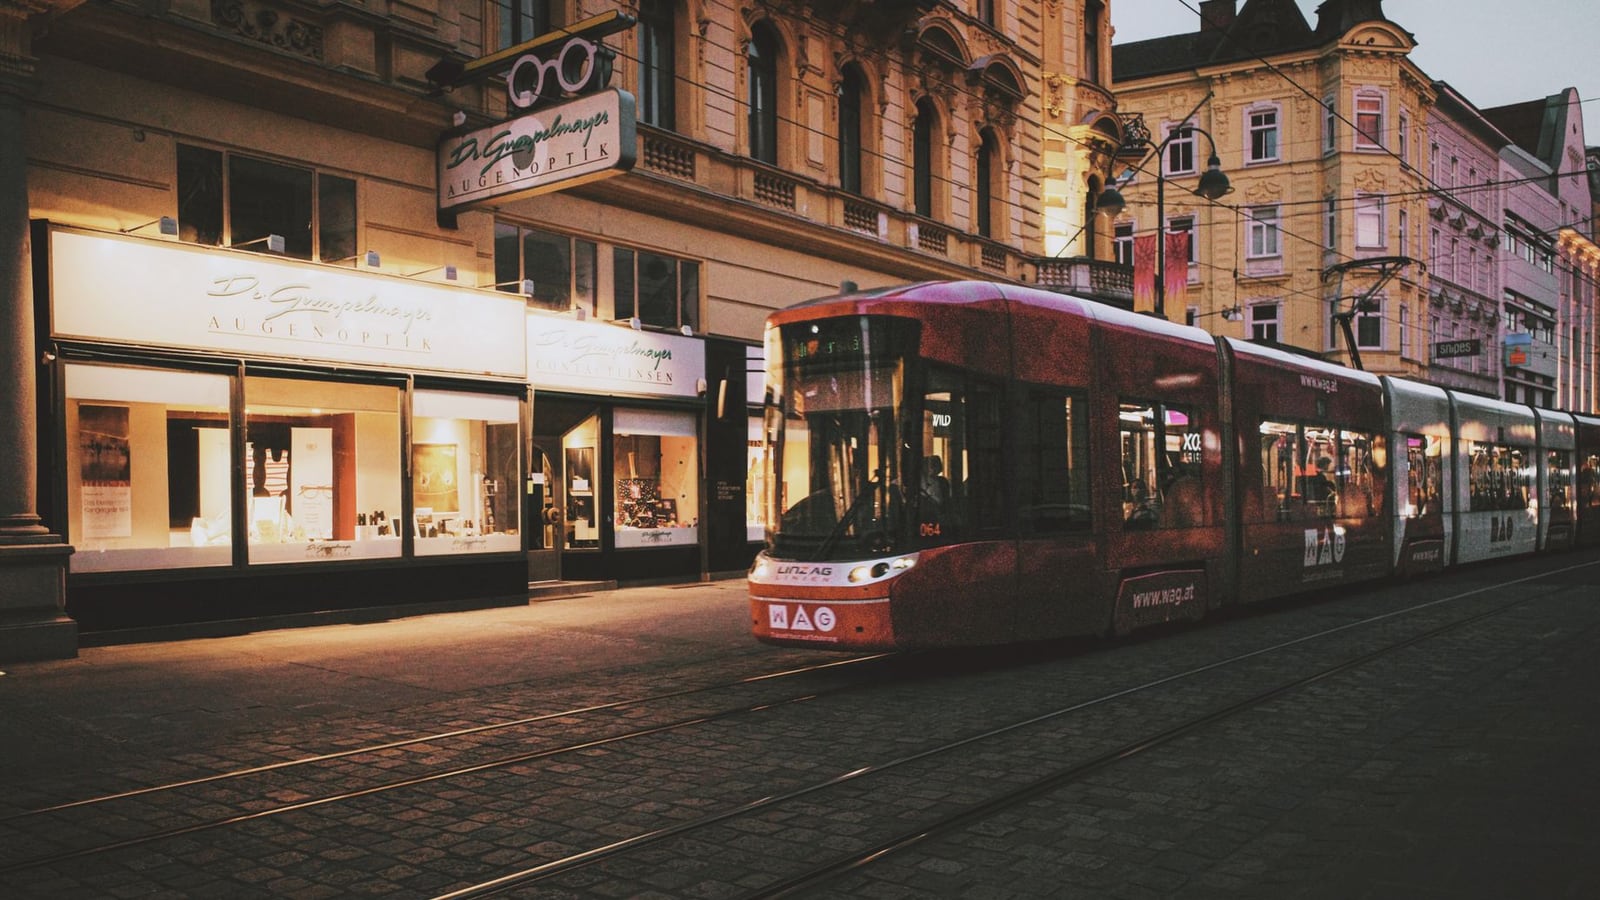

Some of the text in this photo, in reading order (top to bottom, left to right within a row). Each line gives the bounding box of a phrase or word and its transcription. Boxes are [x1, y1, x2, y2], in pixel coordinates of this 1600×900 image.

[480, 110, 609, 176] Gumpelmayer
[447, 143, 609, 197] AUGENOPTIK
[264, 283, 434, 336] Gumpelmayer
[208, 315, 432, 351] AUGENOPTIK
[1439, 342, 1472, 355] snipes
[777, 566, 833, 576] LINZ AG
[1133, 583, 1195, 609] www.wag.at
[770, 606, 836, 631] WAG
